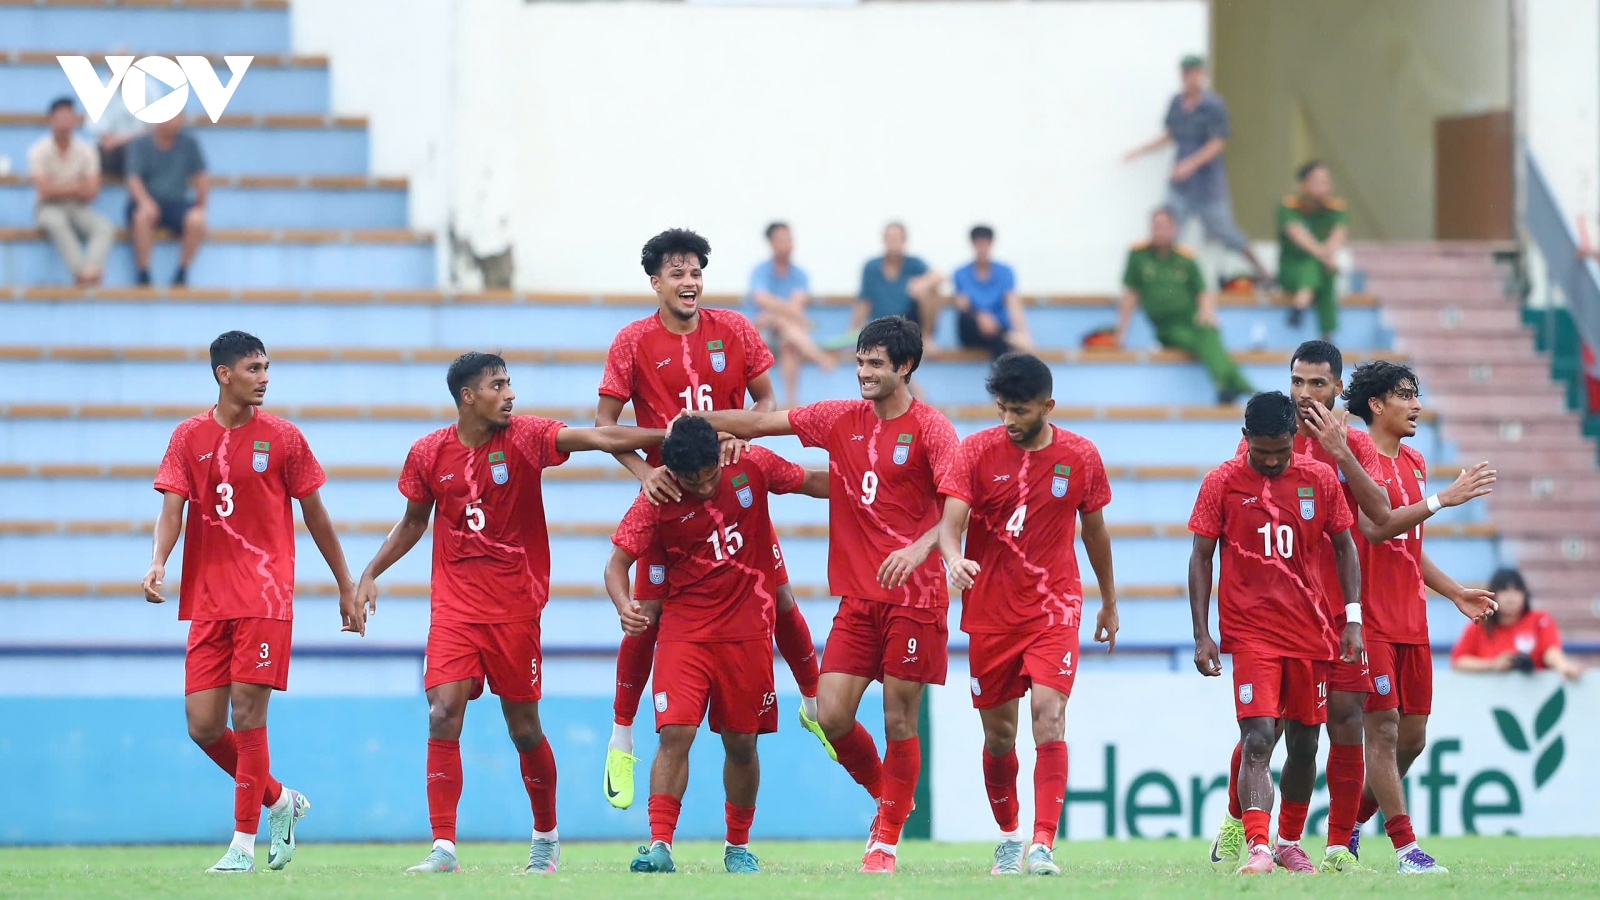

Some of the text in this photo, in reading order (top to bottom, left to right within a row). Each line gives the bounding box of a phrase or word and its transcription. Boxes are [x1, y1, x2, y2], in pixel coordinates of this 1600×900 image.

[678, 384, 713, 411] 16
[215, 482, 234, 517] 3
[861, 471, 879, 505] 9
[465, 498, 486, 531] 5
[1005, 504, 1027, 537] 4
[706, 522, 743, 561] 15
[1257, 522, 1294, 559] 10
[259, 643, 269, 659] 3
[907, 637, 917, 654] 9
[1062, 651, 1072, 667] 4
[531, 658, 537, 675] 5
[761, 691, 776, 706] 15
